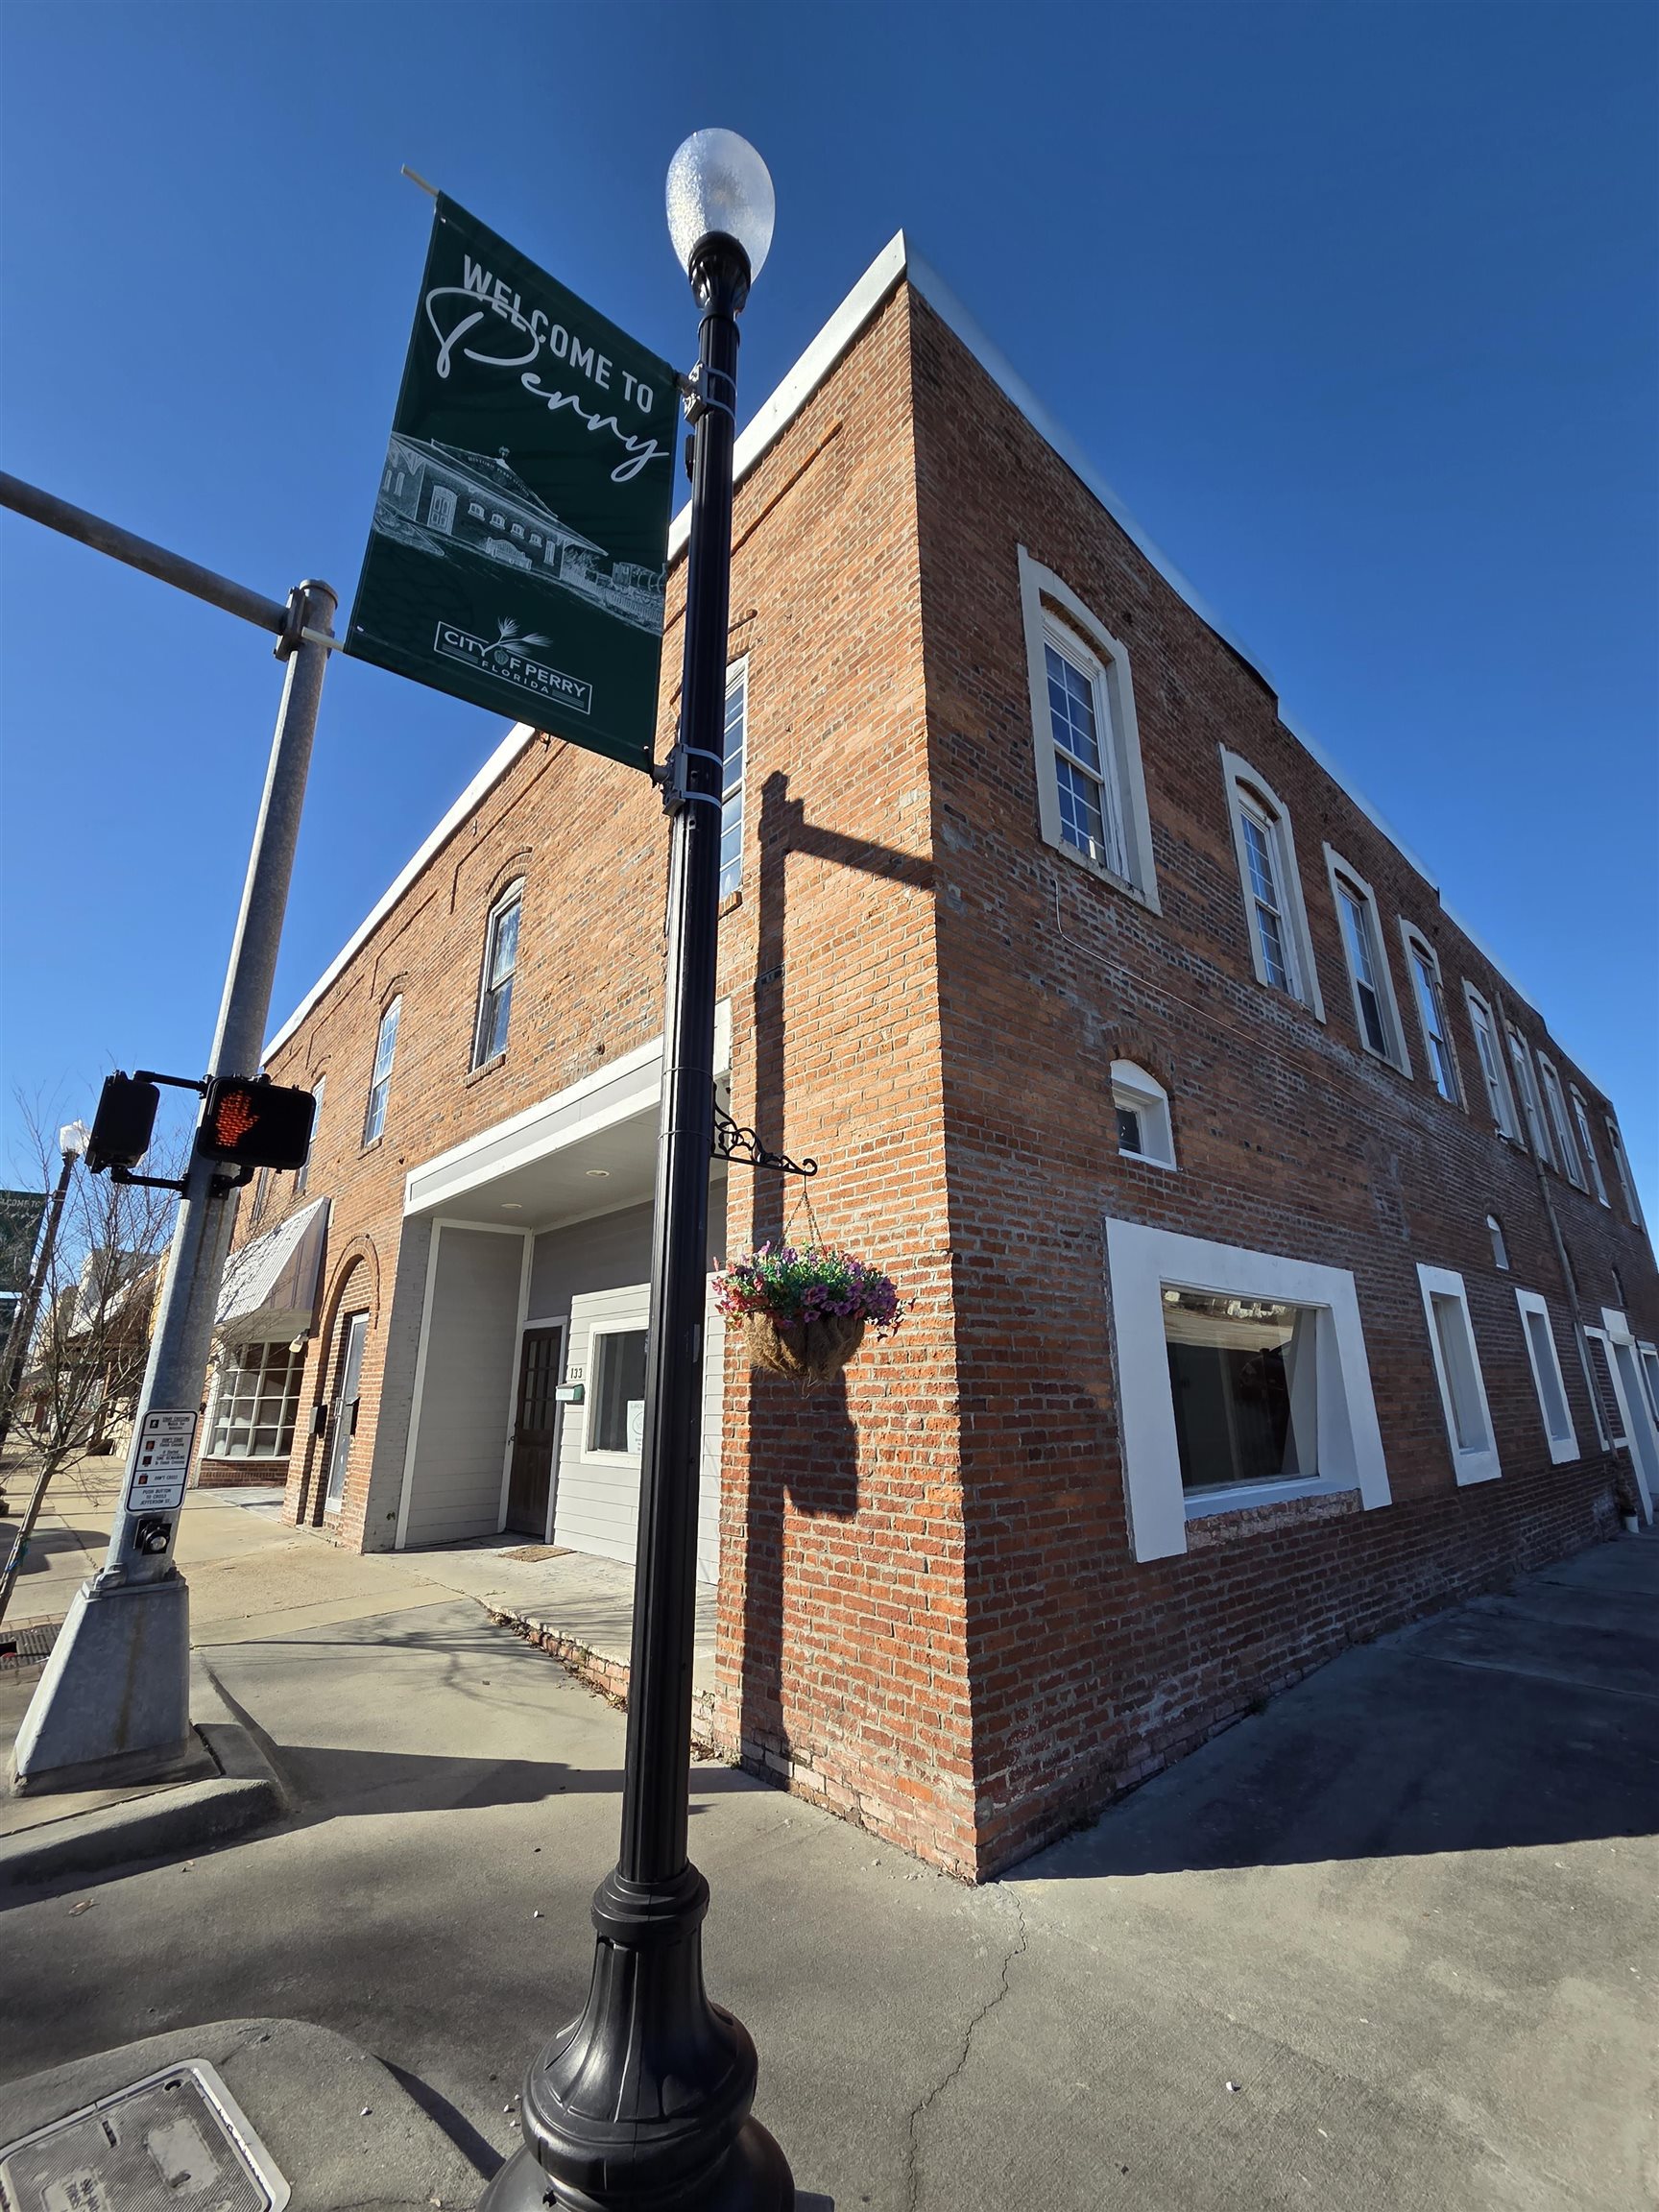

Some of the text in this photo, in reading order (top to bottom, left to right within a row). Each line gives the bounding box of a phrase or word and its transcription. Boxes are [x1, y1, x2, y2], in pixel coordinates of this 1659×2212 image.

[464, 254, 654, 414] WELCOME TO
[444, 630, 496, 658] CITY
[525, 663, 587, 698] PERRY
[481, 660, 549, 694] FLORIDA
[570, 1367, 583, 1379] 133
